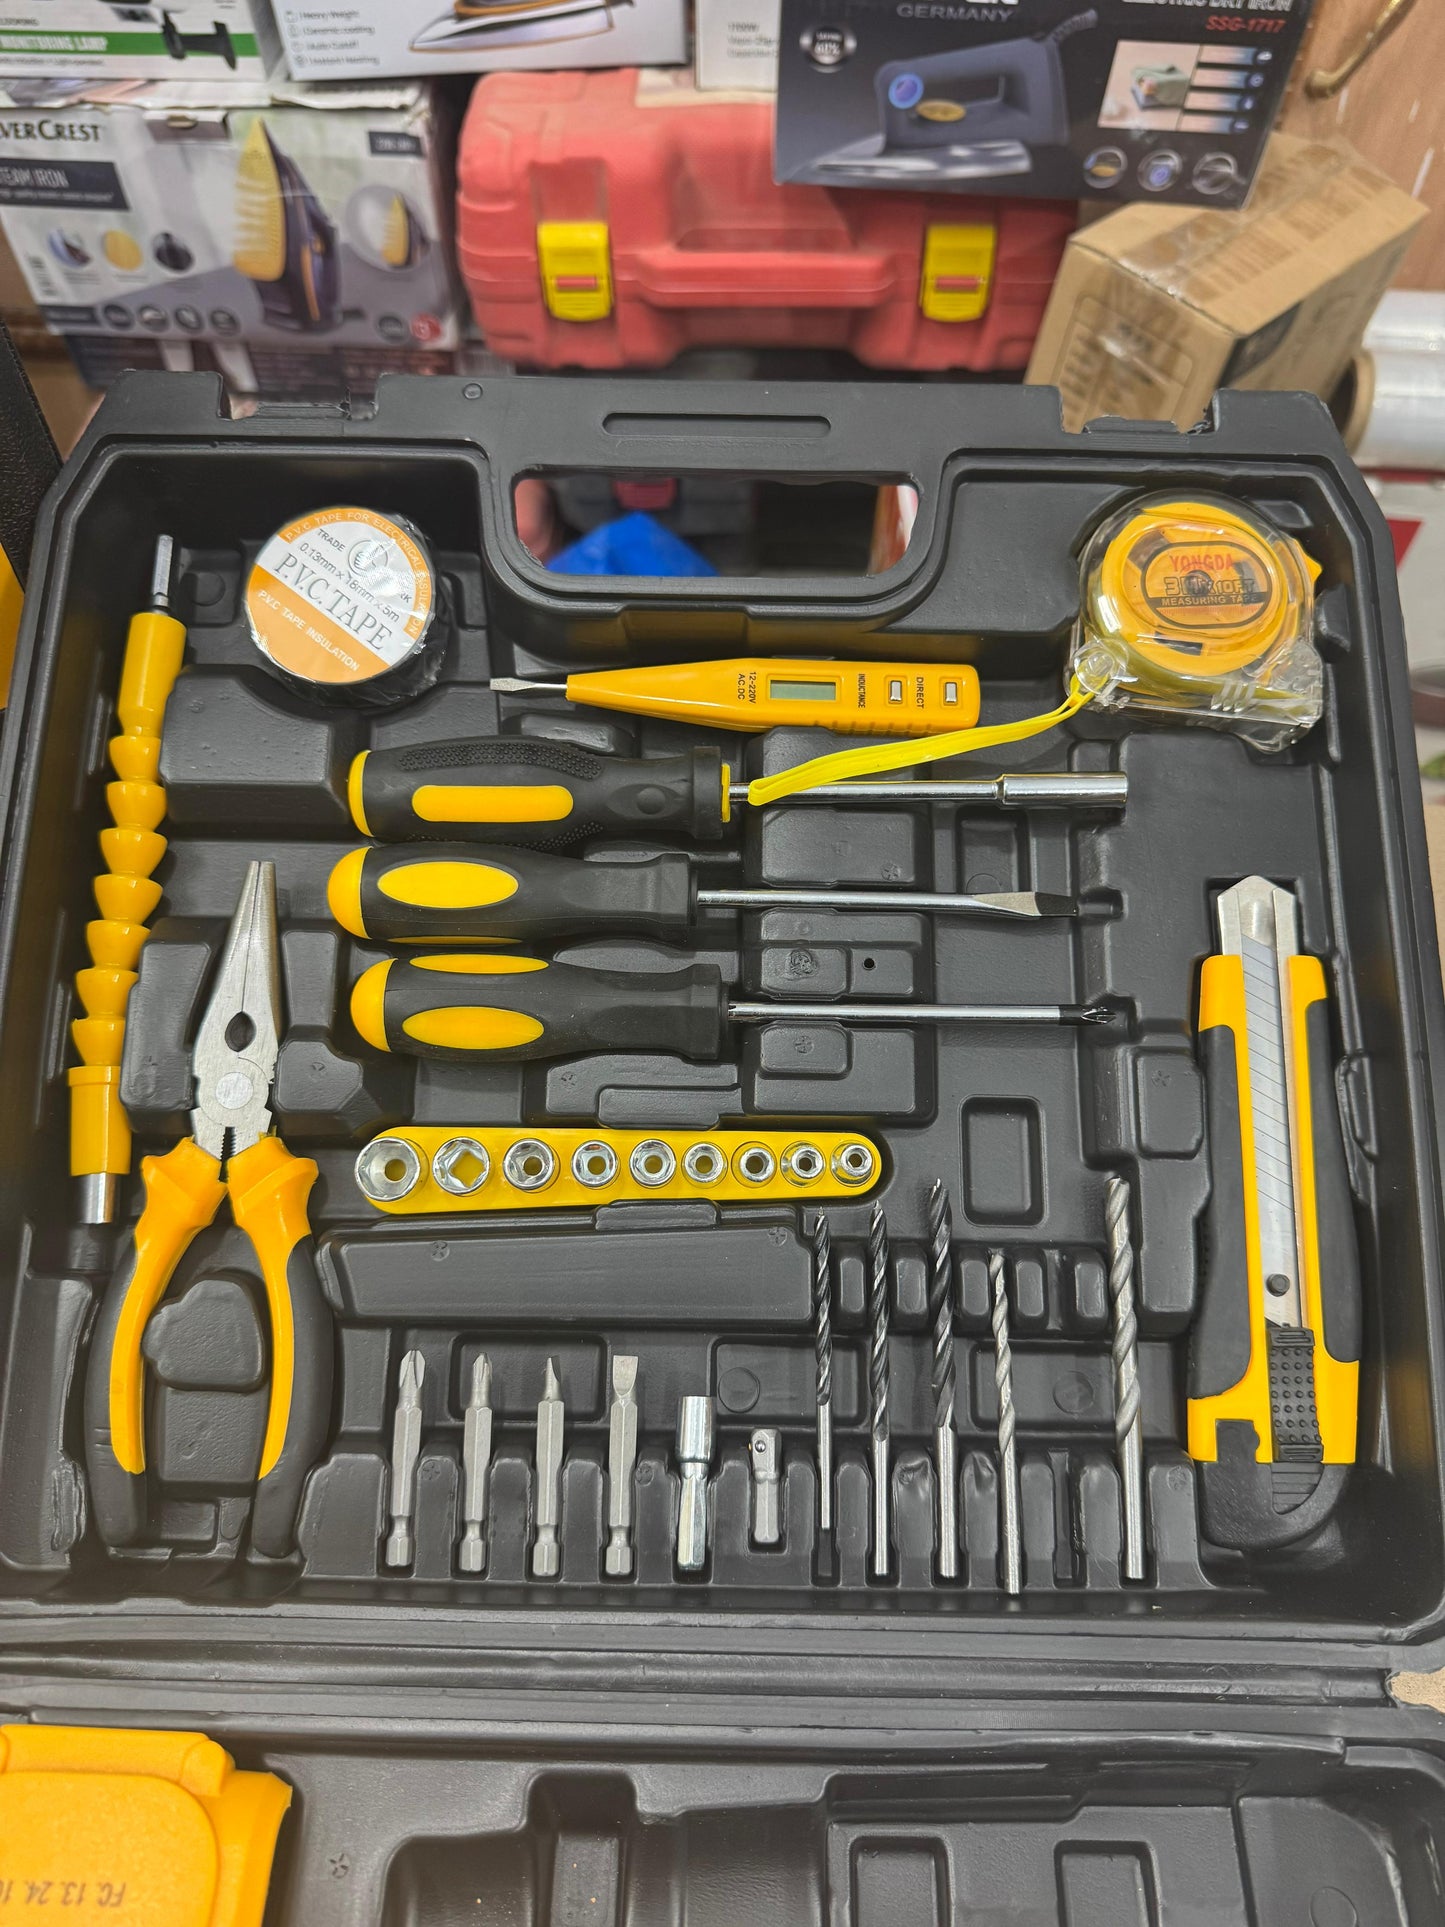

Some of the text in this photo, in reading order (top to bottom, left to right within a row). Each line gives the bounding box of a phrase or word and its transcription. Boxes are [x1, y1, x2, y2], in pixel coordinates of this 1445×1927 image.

[896, 4, 1014, 22] GERMANY
[1206, 15, 1286, 33] SSG-1717
[314, 511, 342, 525] TAPE
[347, 511, 370, 522] FOR
[373, 518, 423, 569] ELECTRICAL
[317, 528, 346, 552] TRADE
[1169, 553, 1235, 572] YONGDA
[1161, 594, 1227, 607] MEASURING
[382, 604, 400, 623] 5m
[281, 606, 307, 630] TAPE
[305, 626, 361, 672] INSULATION
[737, 673, 746, 700] AC.DC
[748, 671, 757, 704] 12-220V
[857, 673, 866, 709] INDUCTANCE
[916, 676, 925, 709] DIRECT
[0, 1880, 14, 1905] 1
